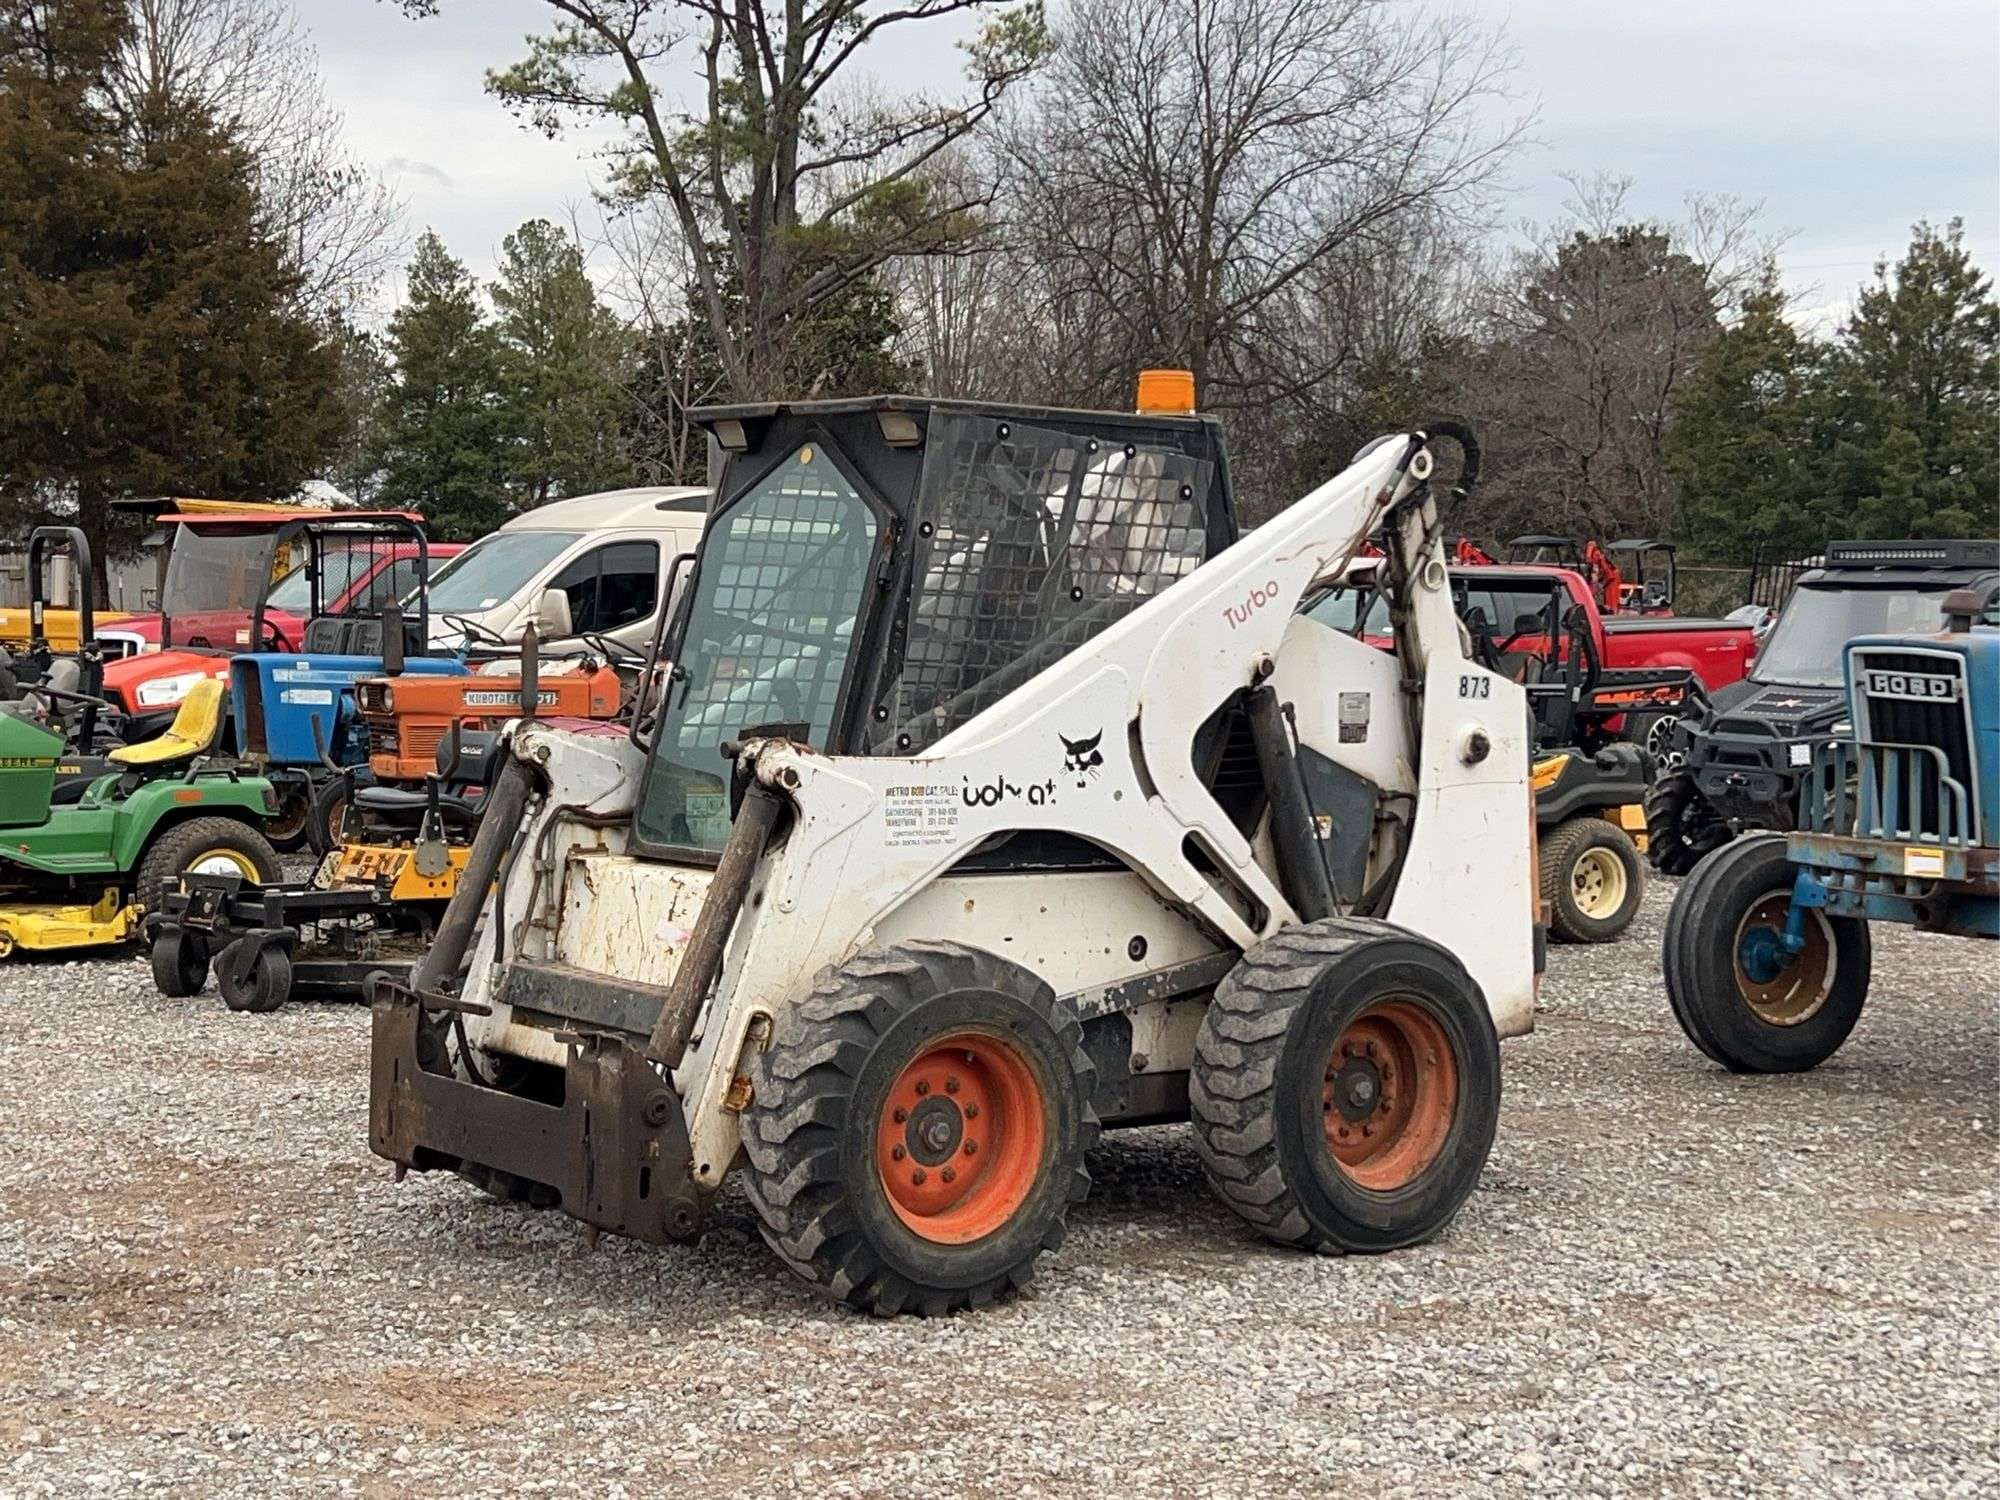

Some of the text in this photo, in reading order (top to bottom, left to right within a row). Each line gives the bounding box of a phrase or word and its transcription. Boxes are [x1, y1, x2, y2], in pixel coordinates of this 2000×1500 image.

[1222, 580, 1279, 630] Turbo
[1459, 676, 1490, 698] 873
[1874, 675, 1948, 696] FORD
[468, 692, 507, 705] KUBOTA
